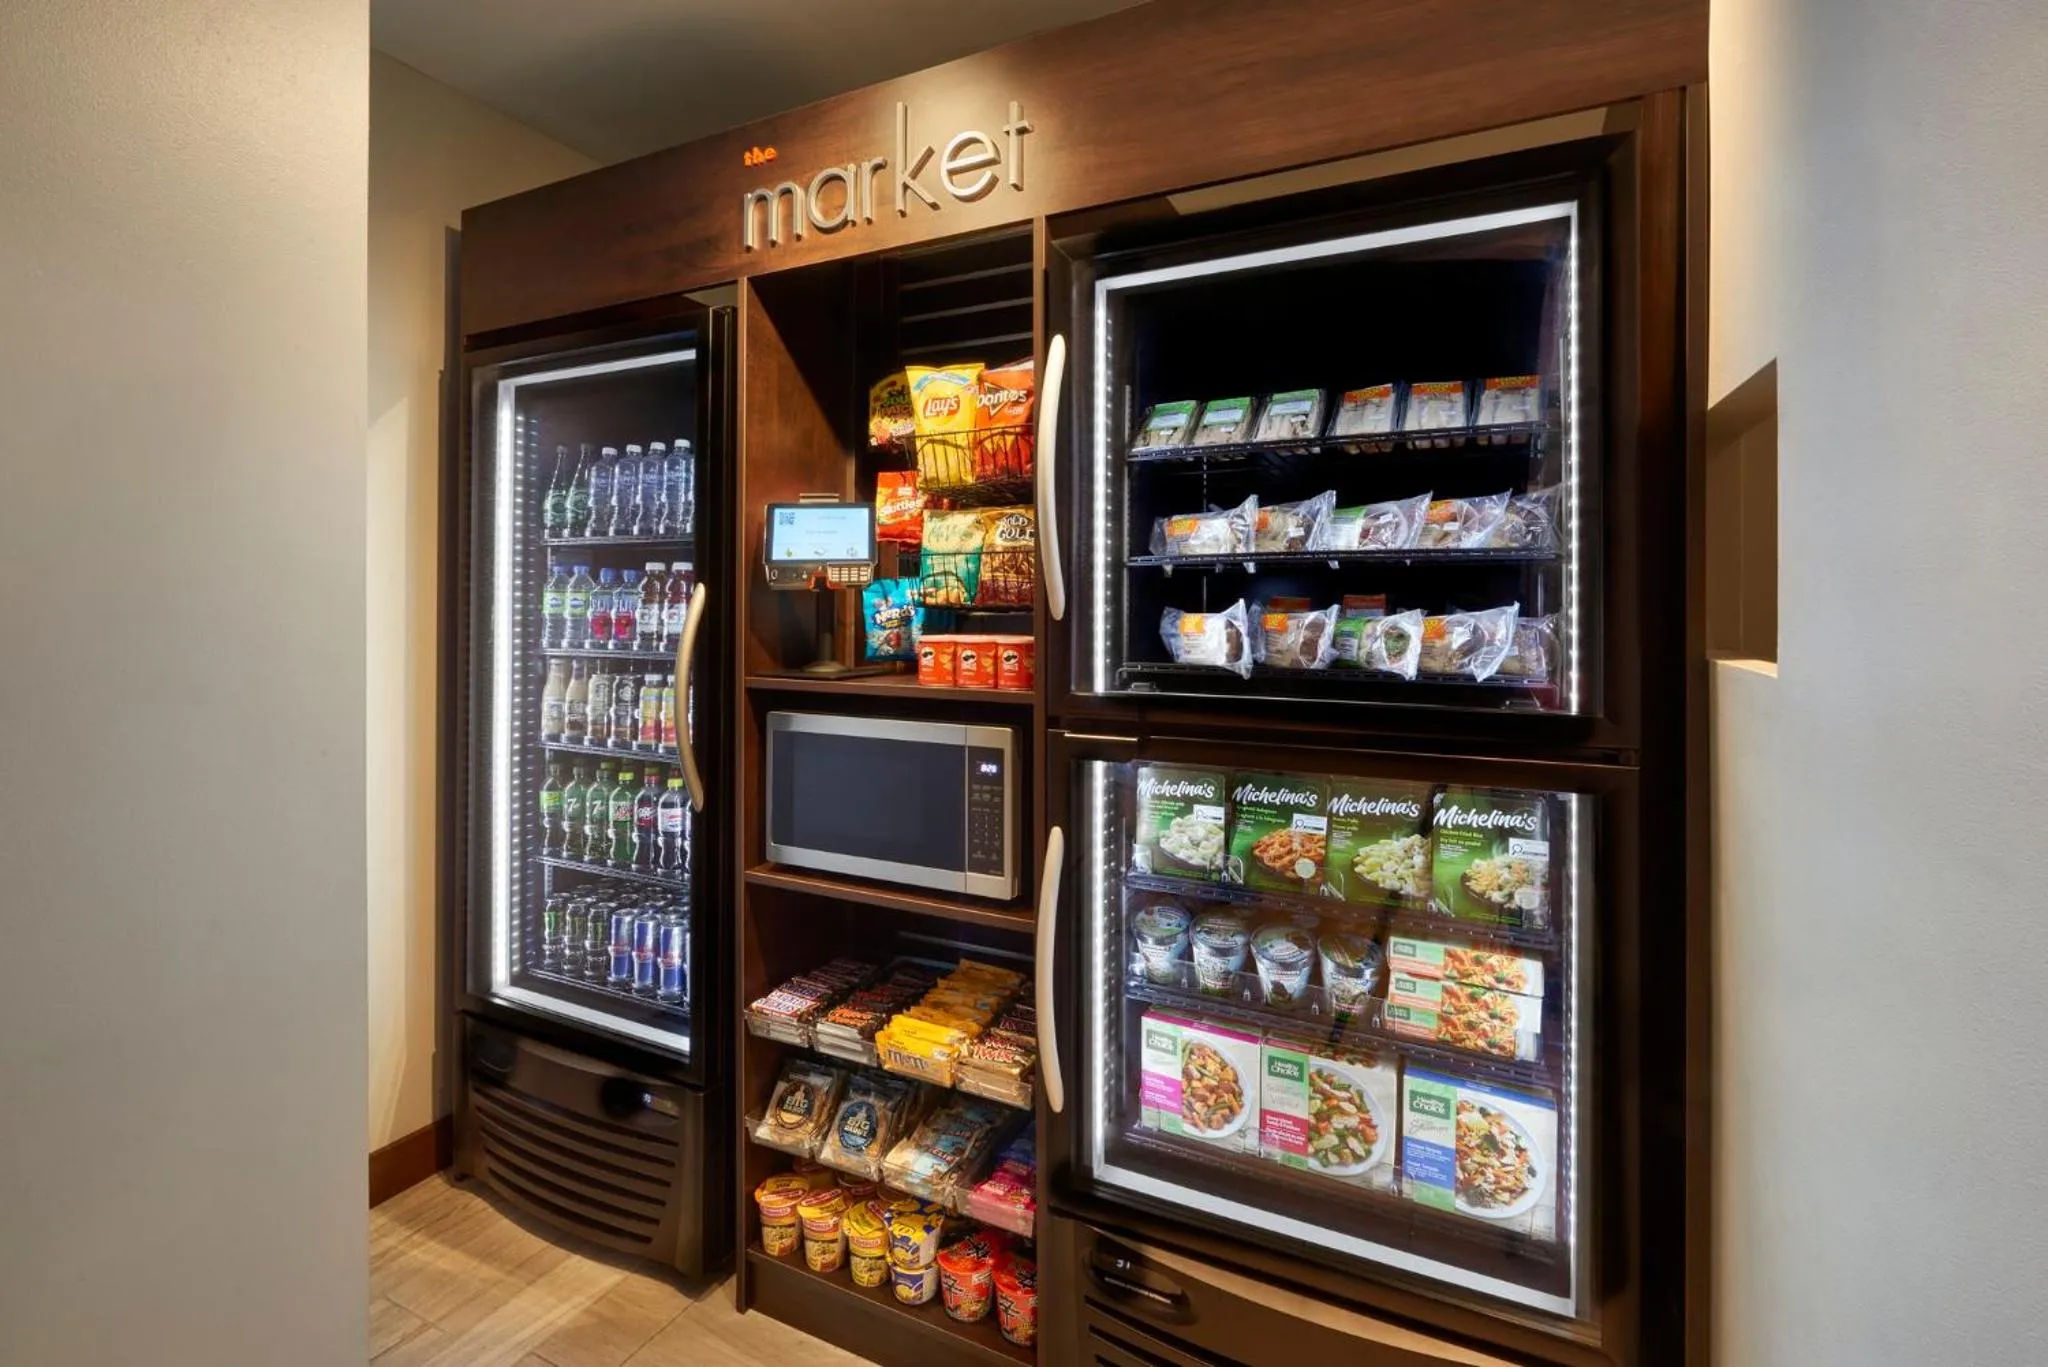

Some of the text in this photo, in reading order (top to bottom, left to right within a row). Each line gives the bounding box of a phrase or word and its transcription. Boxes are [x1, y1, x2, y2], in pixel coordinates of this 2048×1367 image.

[744, 145, 777, 167] the
[743, 100, 1034, 251] market
[925, 395, 958, 417] Lay's
[1136, 777, 1215, 799] Michelina's
[1231, 783, 1318, 808] Michelina's
[1327, 793, 1422, 818] Michelina's
[1432, 804, 1538, 831] Michelina's
